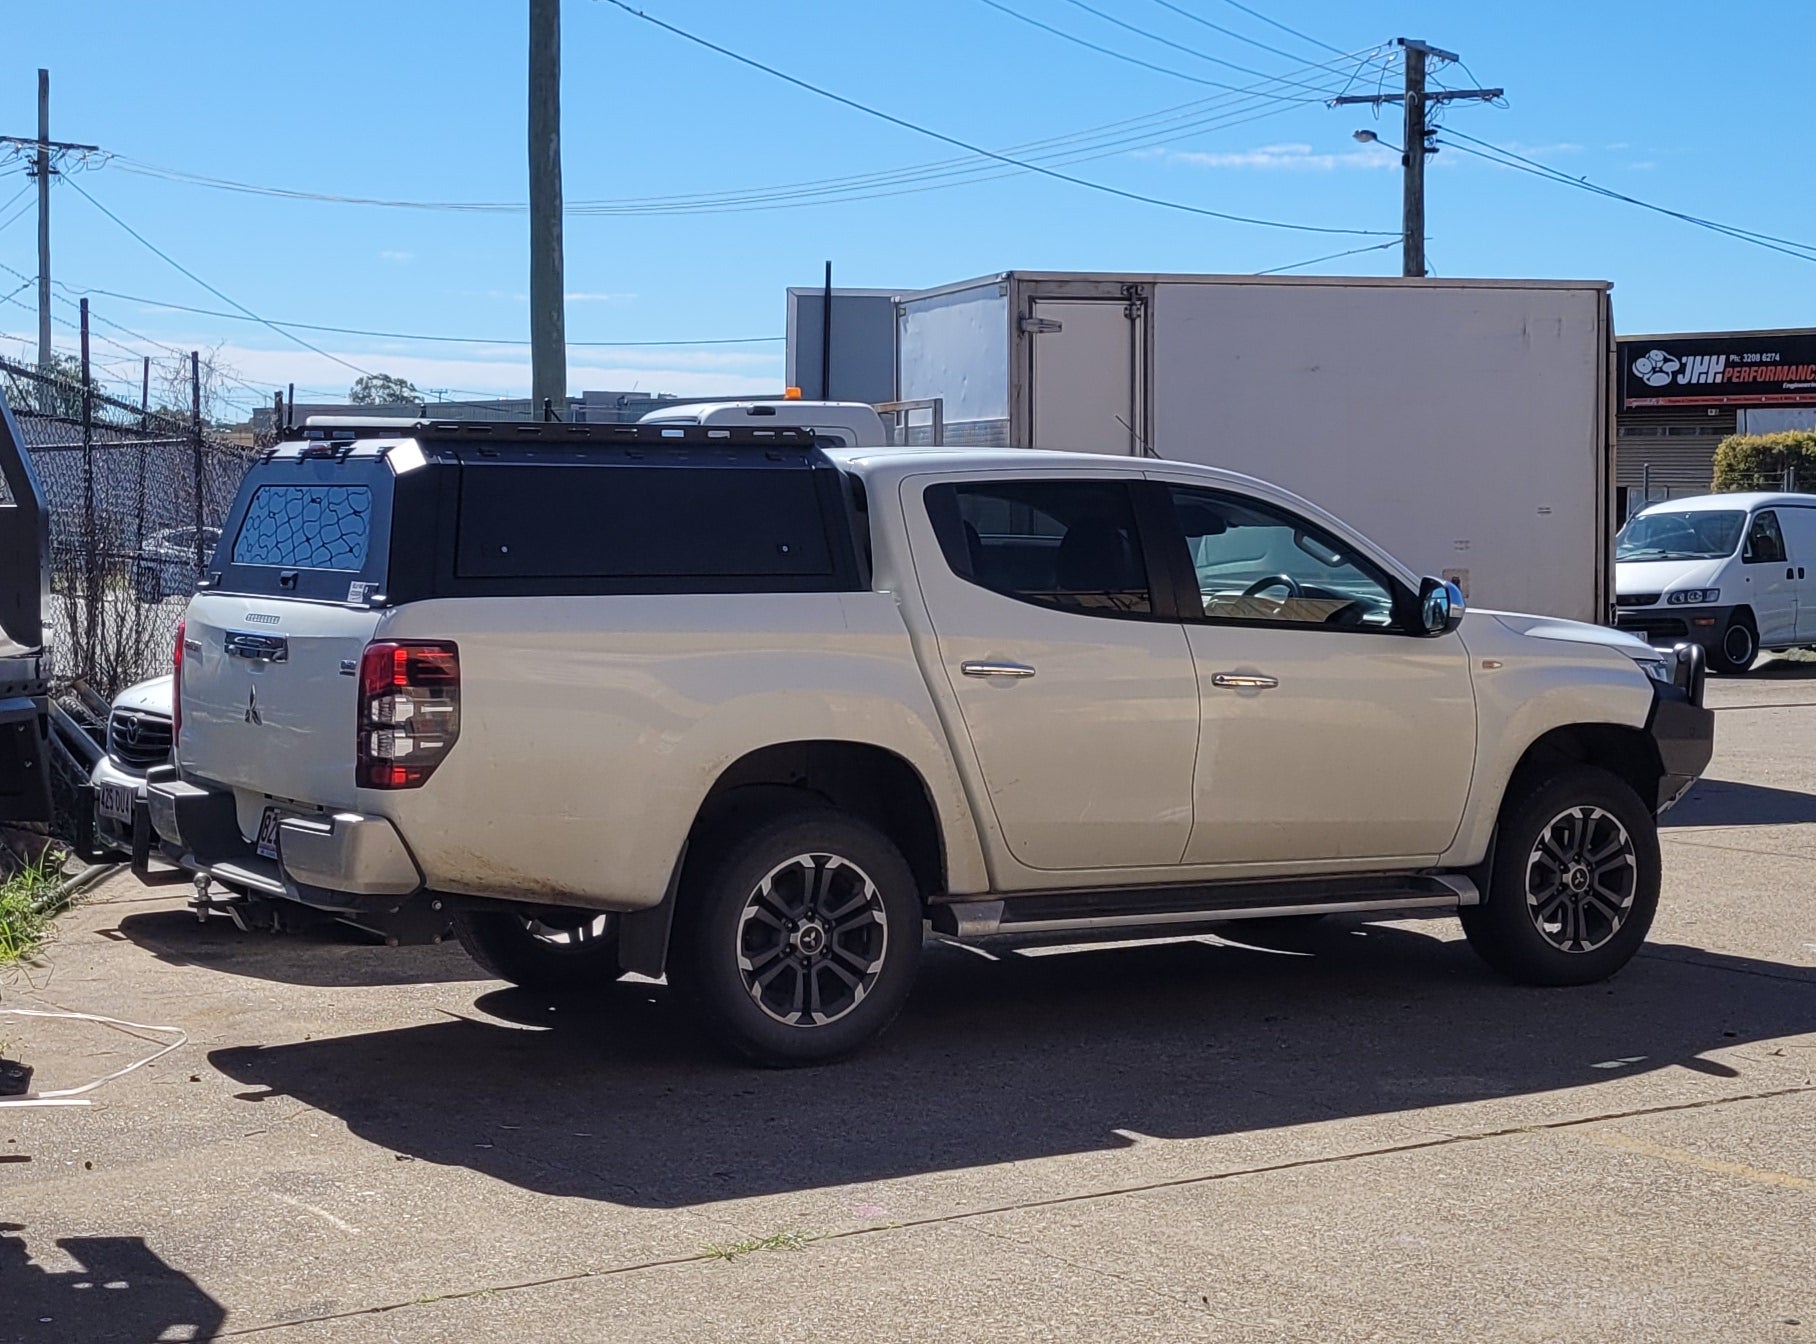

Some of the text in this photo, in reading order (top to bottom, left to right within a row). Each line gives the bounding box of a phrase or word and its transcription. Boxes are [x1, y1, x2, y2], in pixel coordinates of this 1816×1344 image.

[1677, 355, 1726, 384] JHH
[1729, 355, 1741, 363] Ph:
[1762, 353, 1780, 362] 6274
[1724, 365, 1816, 383] PERFORMANC
[261, 814, 278, 844] 82
